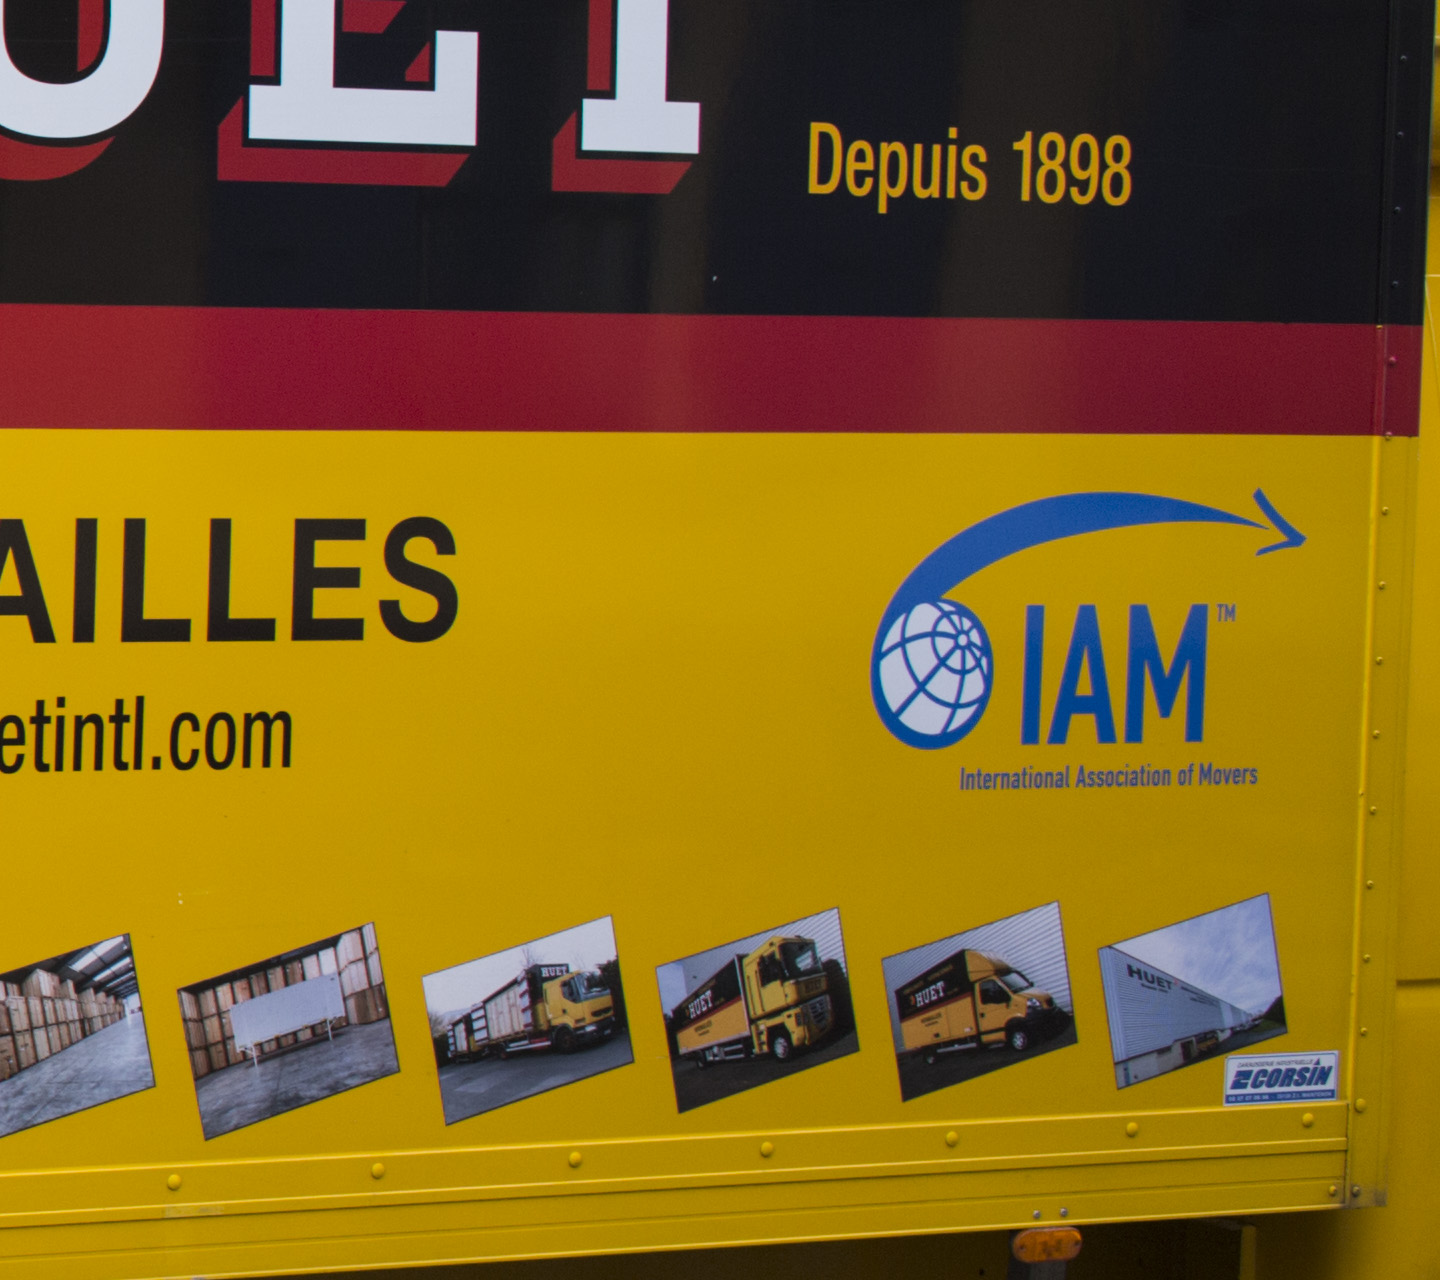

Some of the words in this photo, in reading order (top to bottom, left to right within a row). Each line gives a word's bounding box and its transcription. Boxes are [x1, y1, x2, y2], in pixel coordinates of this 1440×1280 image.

[808, 121, 988, 214] Depuis
[1012, 130, 1132, 206] 1898
[1021, 604, 1209, 745] IAM
[960, 765, 1070, 790] International
[1075, 764, 1171, 788] Association
[1177, 762, 1194, 786] of
[1198, 762, 1258, 785] Movers
[1127, 963, 1173, 990] HUET
[688, 989, 713, 1020] HUET
[915, 980, 945, 1008] HUET
[1250, 1066, 1333, 1089] CORSIN
